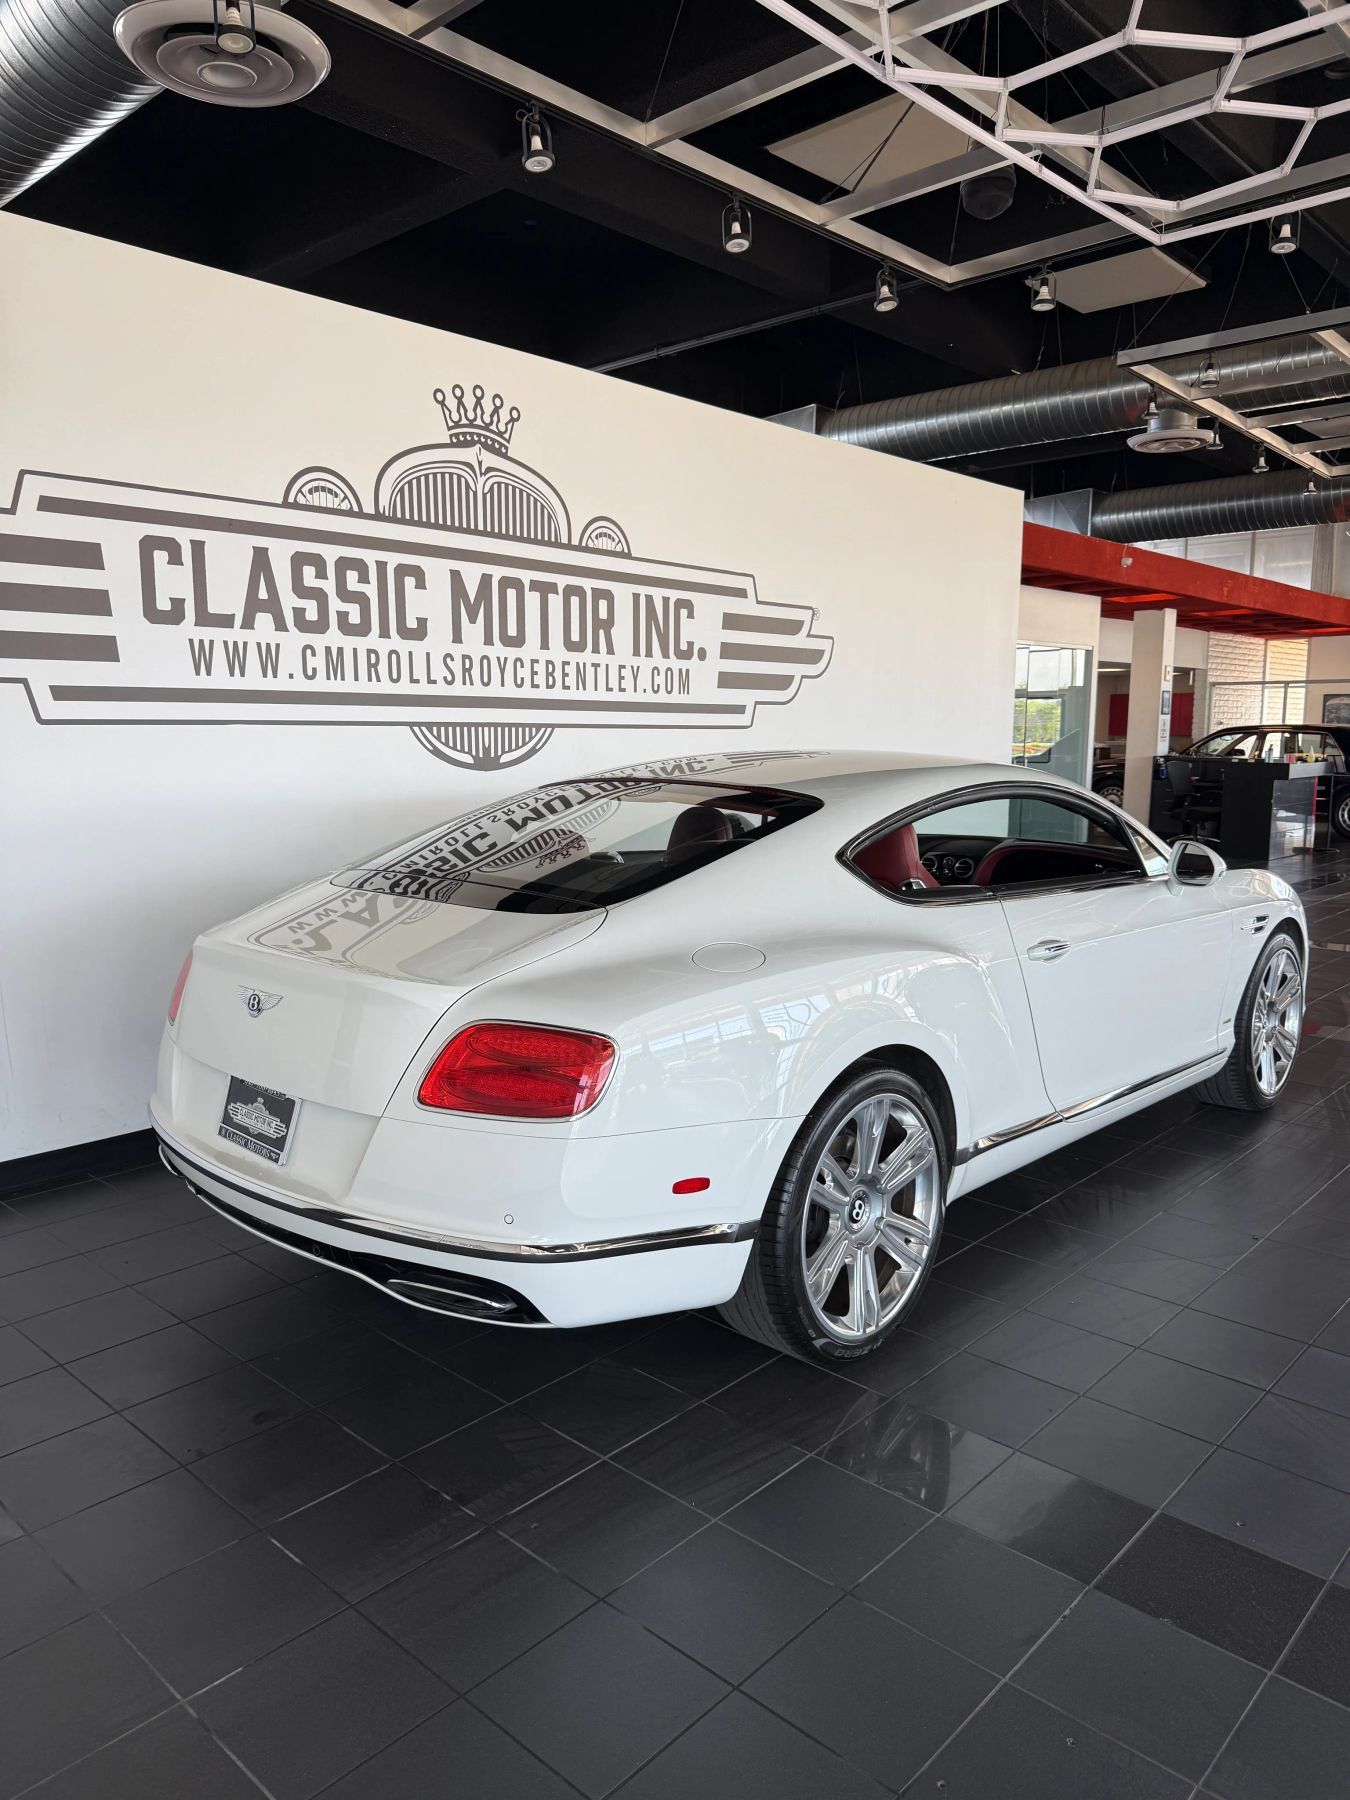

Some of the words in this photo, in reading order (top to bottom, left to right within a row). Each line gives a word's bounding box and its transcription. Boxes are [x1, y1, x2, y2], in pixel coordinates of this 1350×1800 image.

[138, 534, 429, 641] CLASSIC
[449, 568, 616, 655] MOTOR
[632, 592, 707, 662] INC.
[188, 638, 691, 695] WWW.CMIROLLSROYCEBENTLEY.COM
